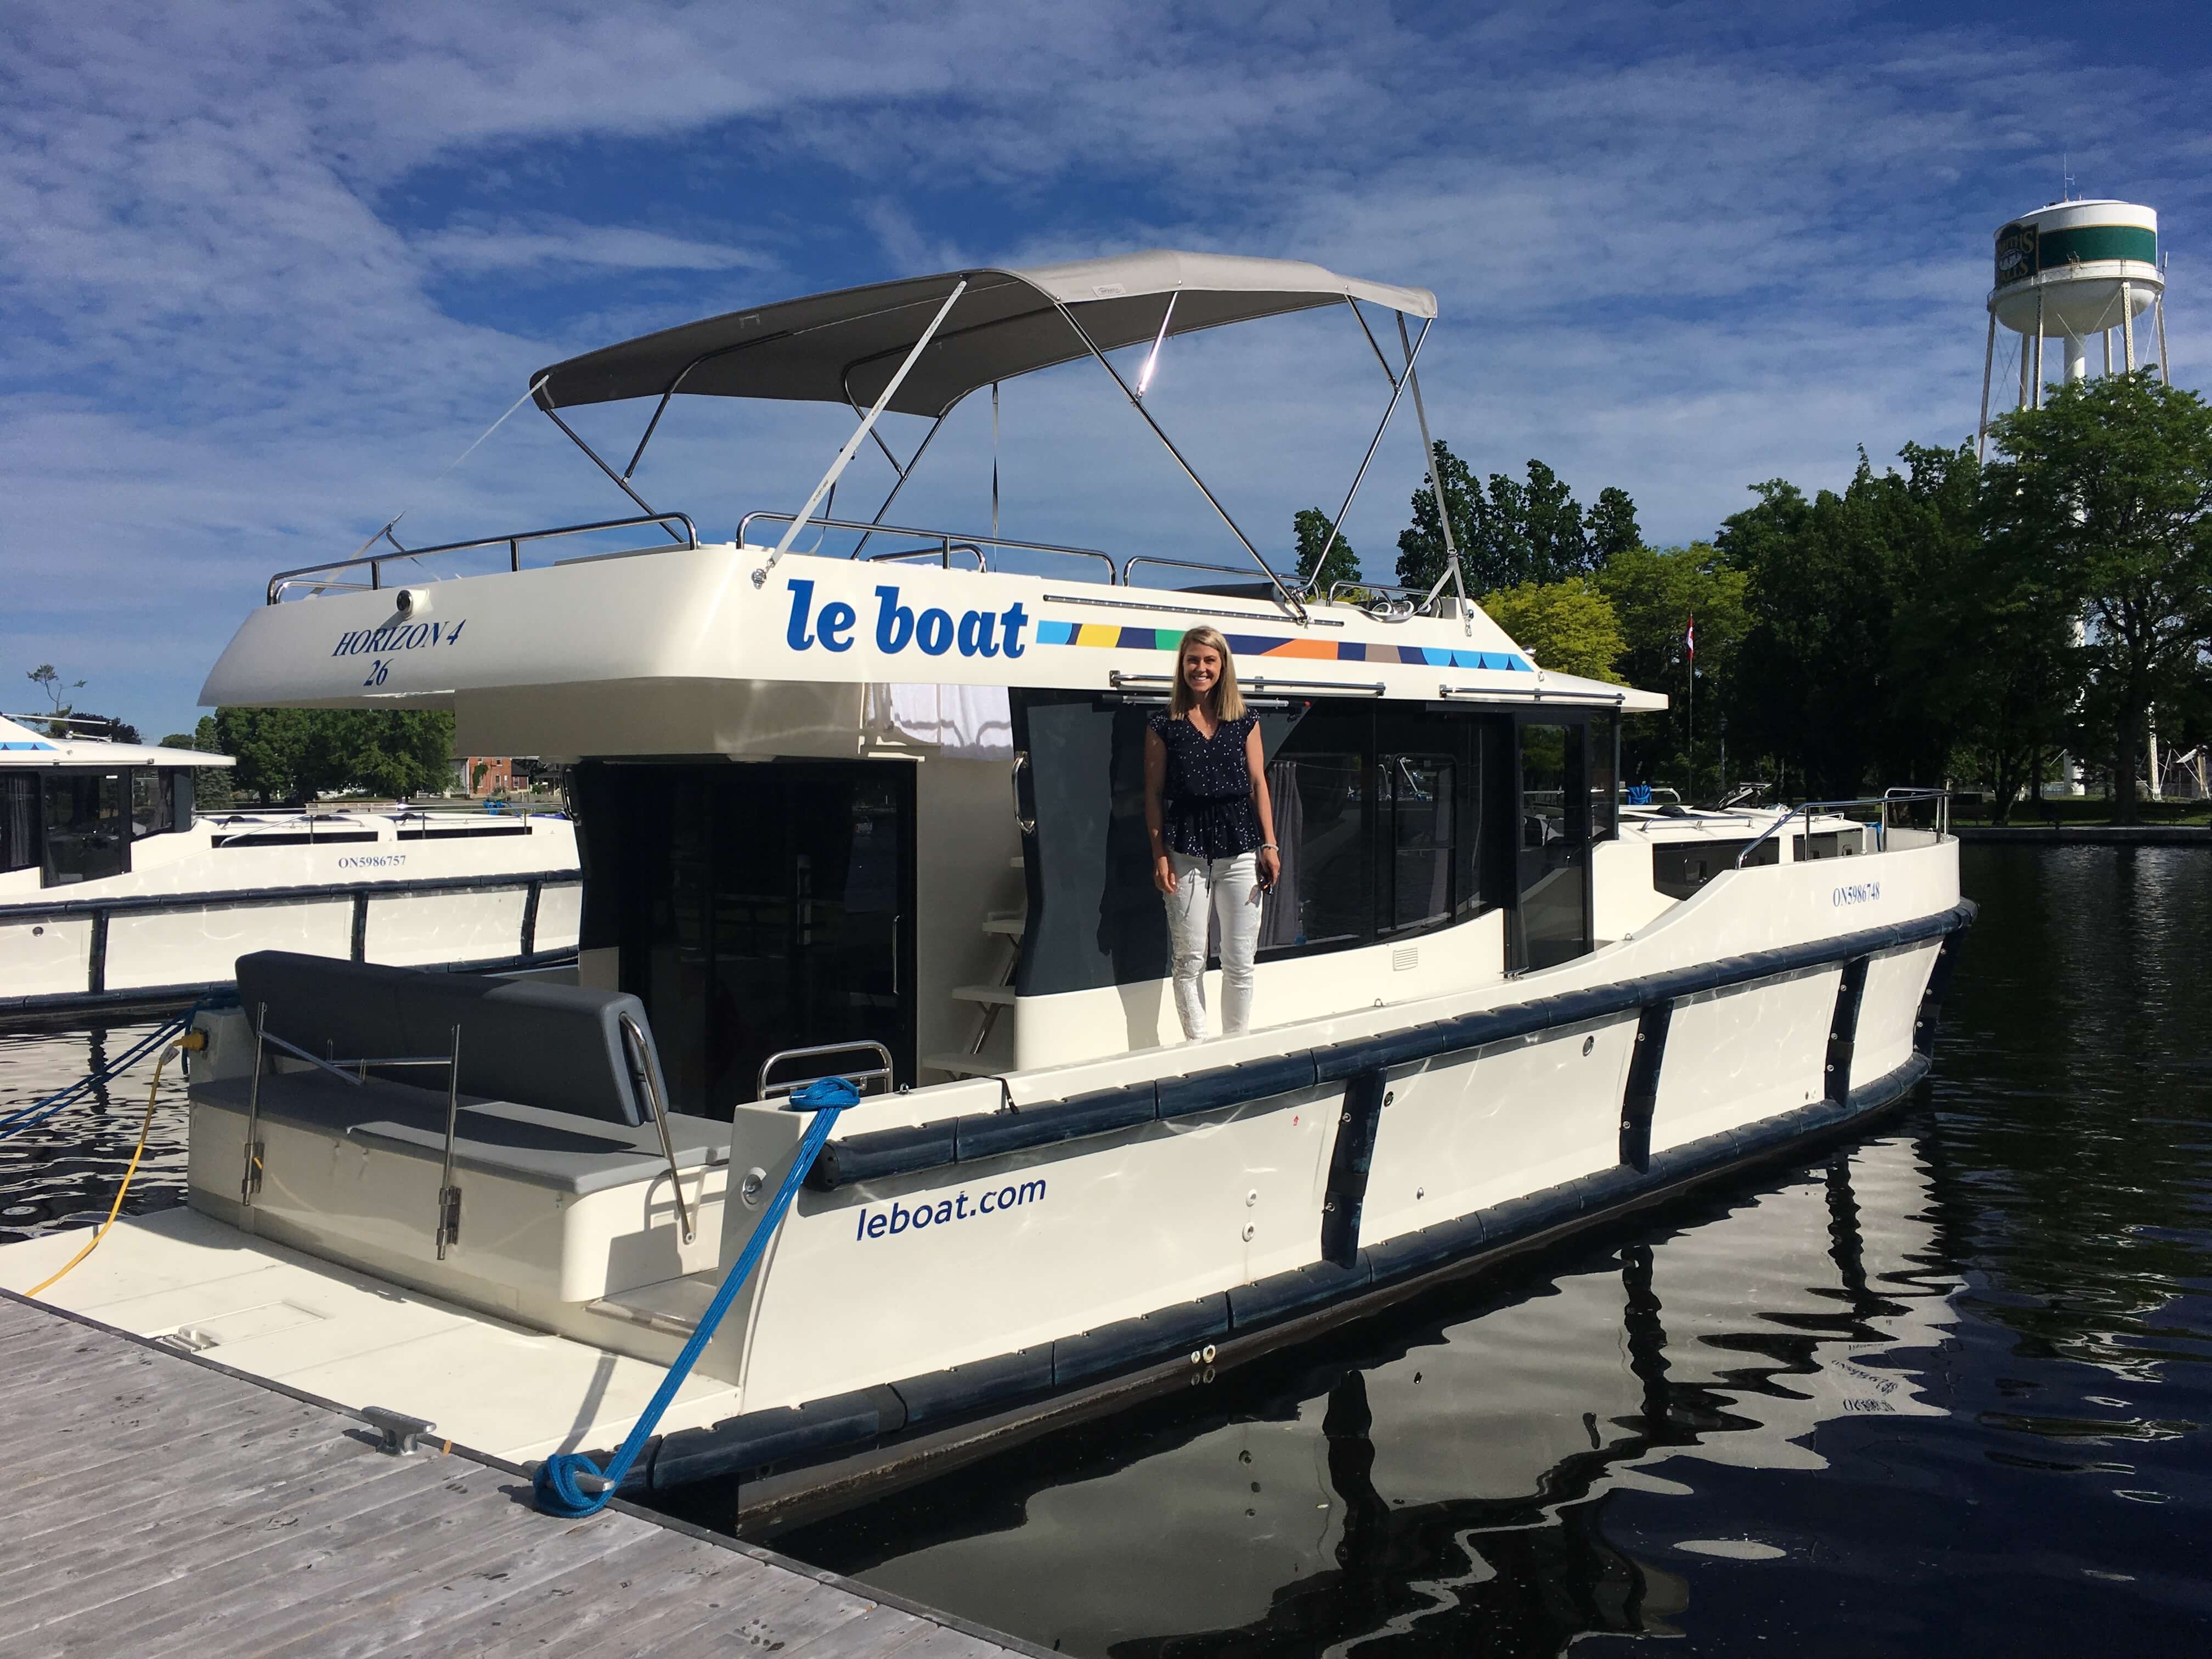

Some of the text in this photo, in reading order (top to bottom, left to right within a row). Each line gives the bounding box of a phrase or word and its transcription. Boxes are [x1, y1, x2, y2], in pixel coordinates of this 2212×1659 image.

[787, 579, 1029, 658] le boat
[331, 619, 466, 657] HORIZON 4
[363, 658, 394, 686] 26
[338, 855, 406, 868] ON5986757
[1833, 882, 1880, 907] ON5986748
[856, 1179, 1046, 1241] leboat.com
